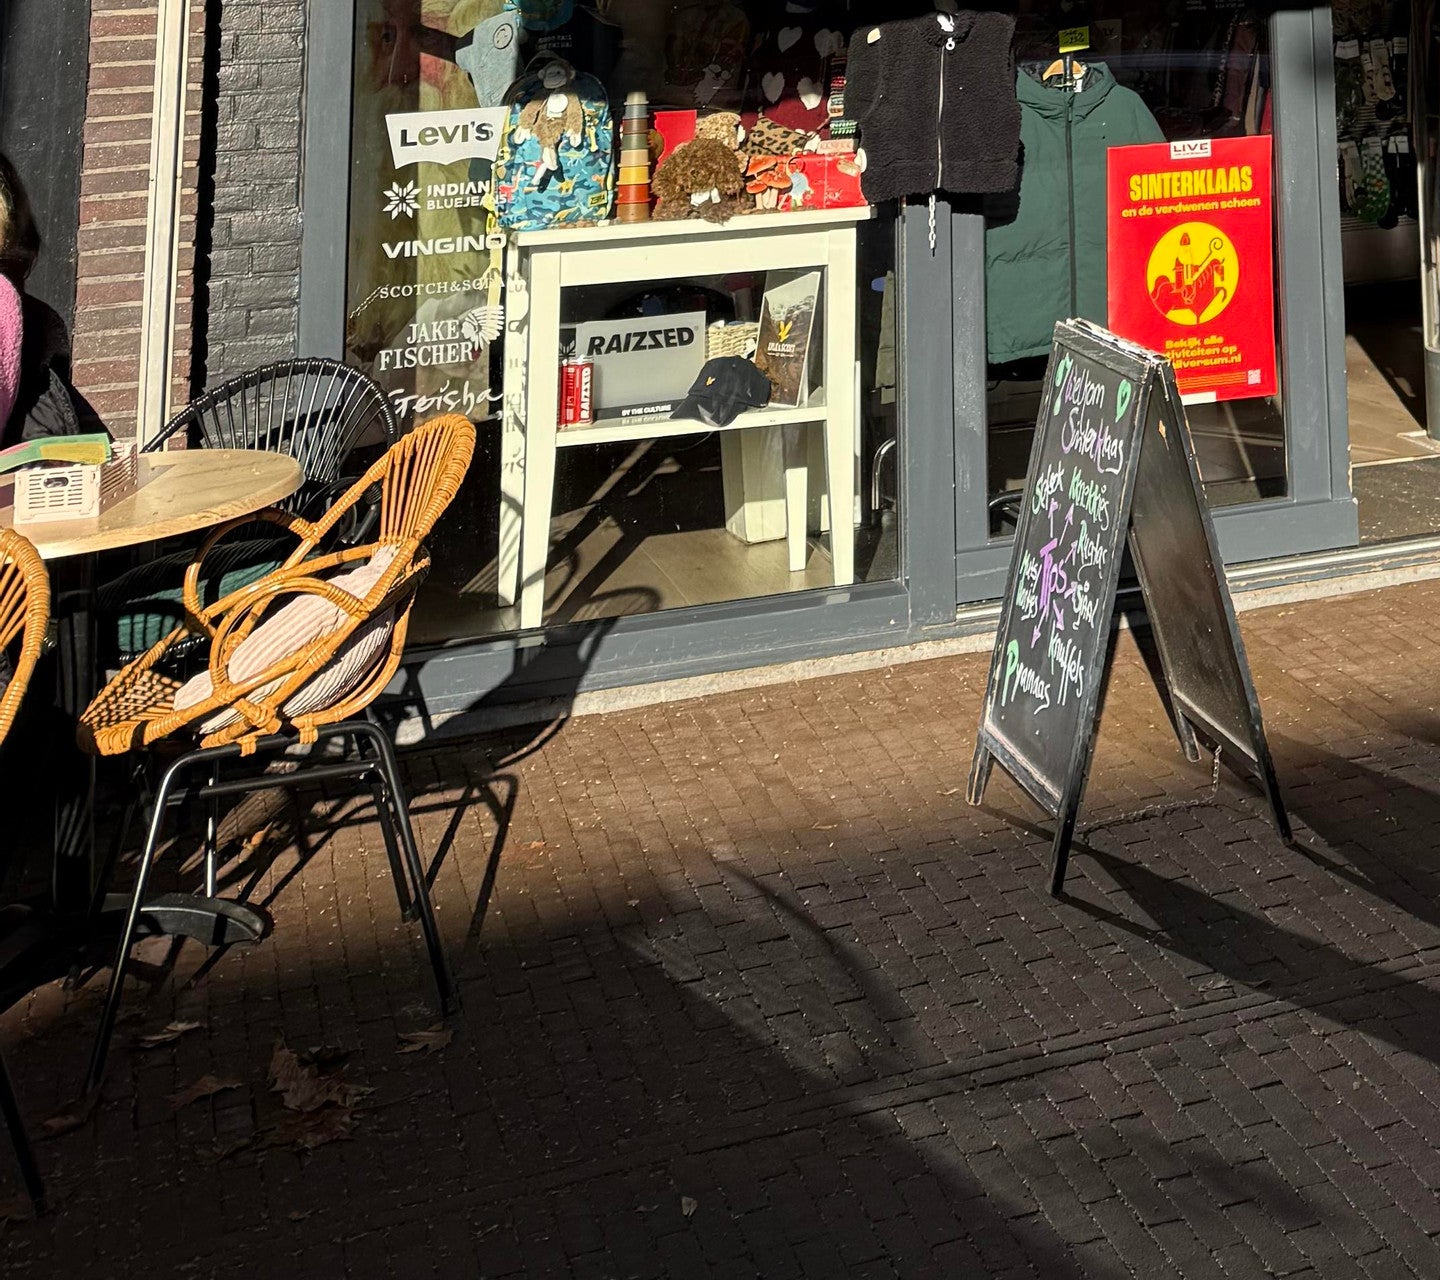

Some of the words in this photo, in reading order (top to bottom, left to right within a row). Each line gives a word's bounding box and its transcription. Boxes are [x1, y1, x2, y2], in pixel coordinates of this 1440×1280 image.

[1174, 142, 1208, 152] LIVE
[427, 180, 490, 197] INDIAN
[1129, 166, 1252, 202] SINTERKLAAS
[1121, 208, 1137, 218] en
[1138, 204, 1153, 216] de
[1155, 200, 1219, 214] verdwenen
[1220, 197, 1260, 210] schoen
[381, 233, 507, 259] VINGINO
[406, 320, 459, 344] JAKE
[379, 342, 473, 371] FISCHER
[1165, 346, 1220, 359] tiviteiten
[1222, 345, 1237, 355] op
[1172, 353, 1241, 370] hilversum.nl
[388, 380, 504, 419] Geisha
[1048, 620, 1085, 706] Knuffels
